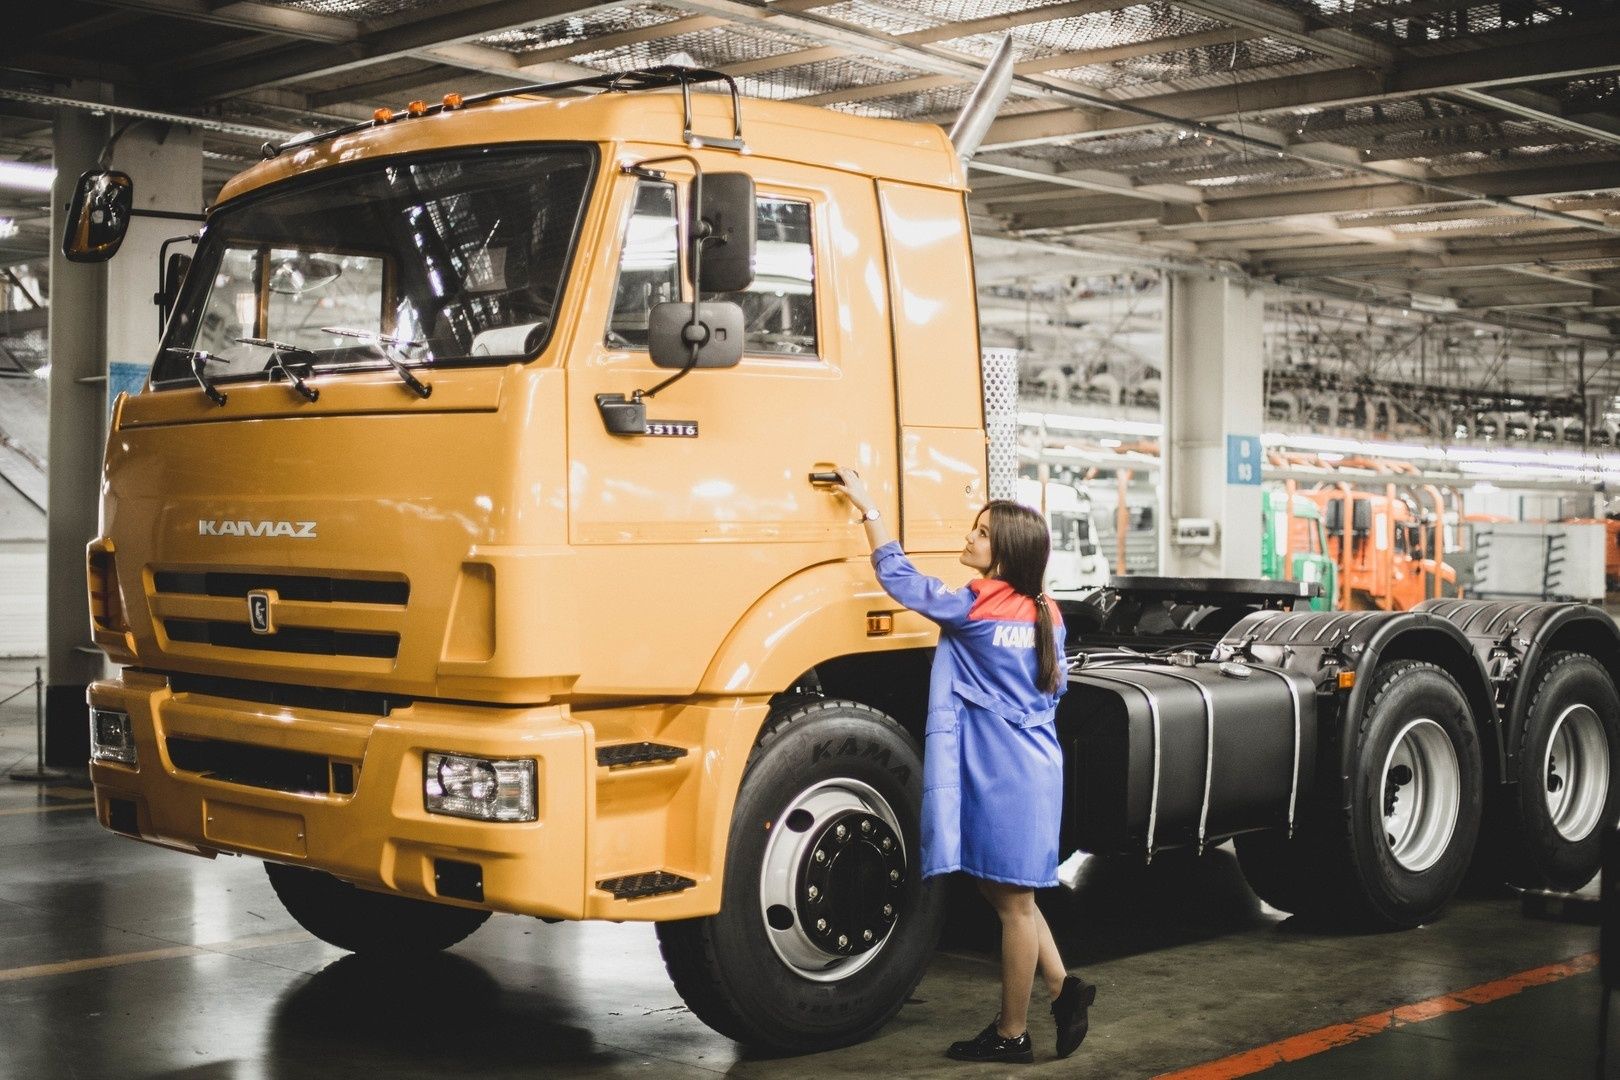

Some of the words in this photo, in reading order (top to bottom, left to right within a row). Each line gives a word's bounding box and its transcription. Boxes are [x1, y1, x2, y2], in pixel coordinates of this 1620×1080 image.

[199, 520, 316, 537] KAMAZ
[992, 626, 1035, 648] KAM
[812, 736, 911, 786] KAMA
